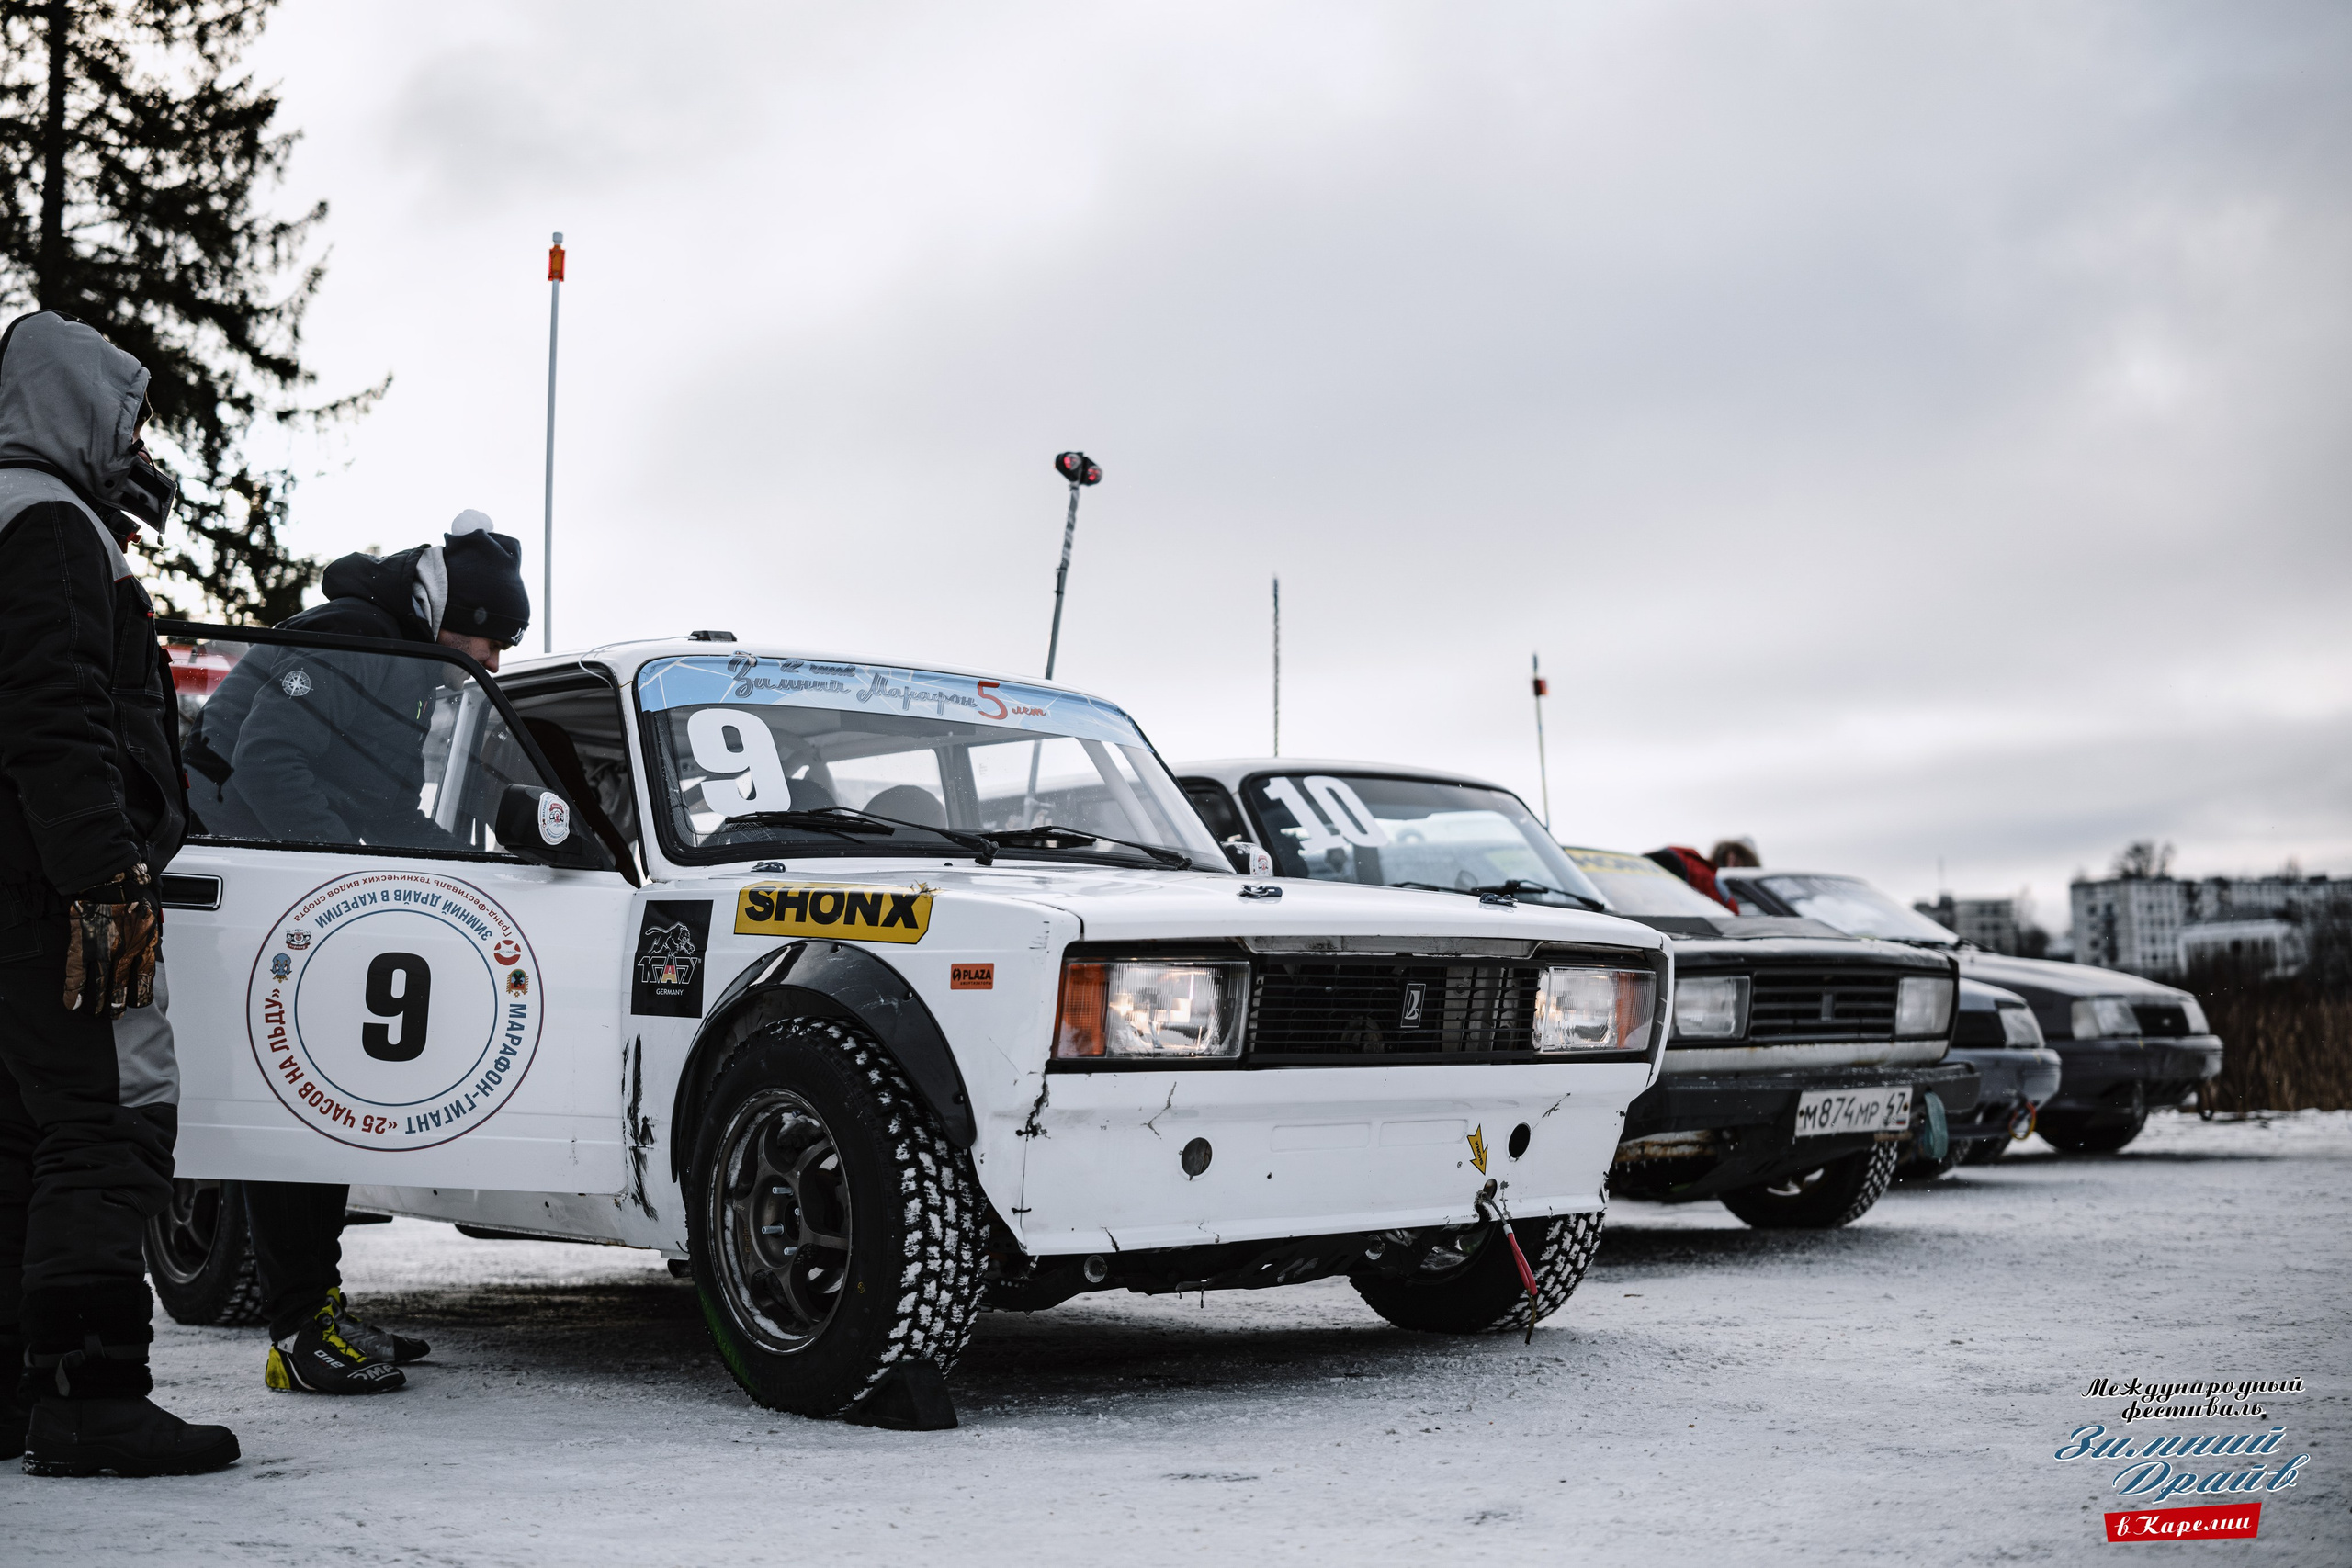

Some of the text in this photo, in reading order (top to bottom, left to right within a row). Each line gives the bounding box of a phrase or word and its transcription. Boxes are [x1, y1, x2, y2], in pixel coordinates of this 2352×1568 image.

[728, 654, 852, 698] Зимний
[856, 672, 978, 716] Марафон
[977, 680, 1009, 720] 5
[686, 707, 791, 818] 9
[1263, 775, 1388, 850] 10
[294, 895, 326, 921] спорта
[327, 880, 360, 897] видов
[744, 886, 919, 929] SHONX
[315, 889, 492, 942] ЗИМНИЙ ДРАЙВ В КАРЕЛИИ
[656, 987, 684, 996] GERMANY
[963, 969, 992, 980] PLAZA
[265, 987, 290, 1054] ЛЬДУ»
[362, 952, 432, 1062] 9
[278, 1055, 305, 1085] НА
[405, 1003, 527, 1134] МАРАФОН-ГИГАНТ
[298, 1081, 356, 1128] ЧАСОВ
